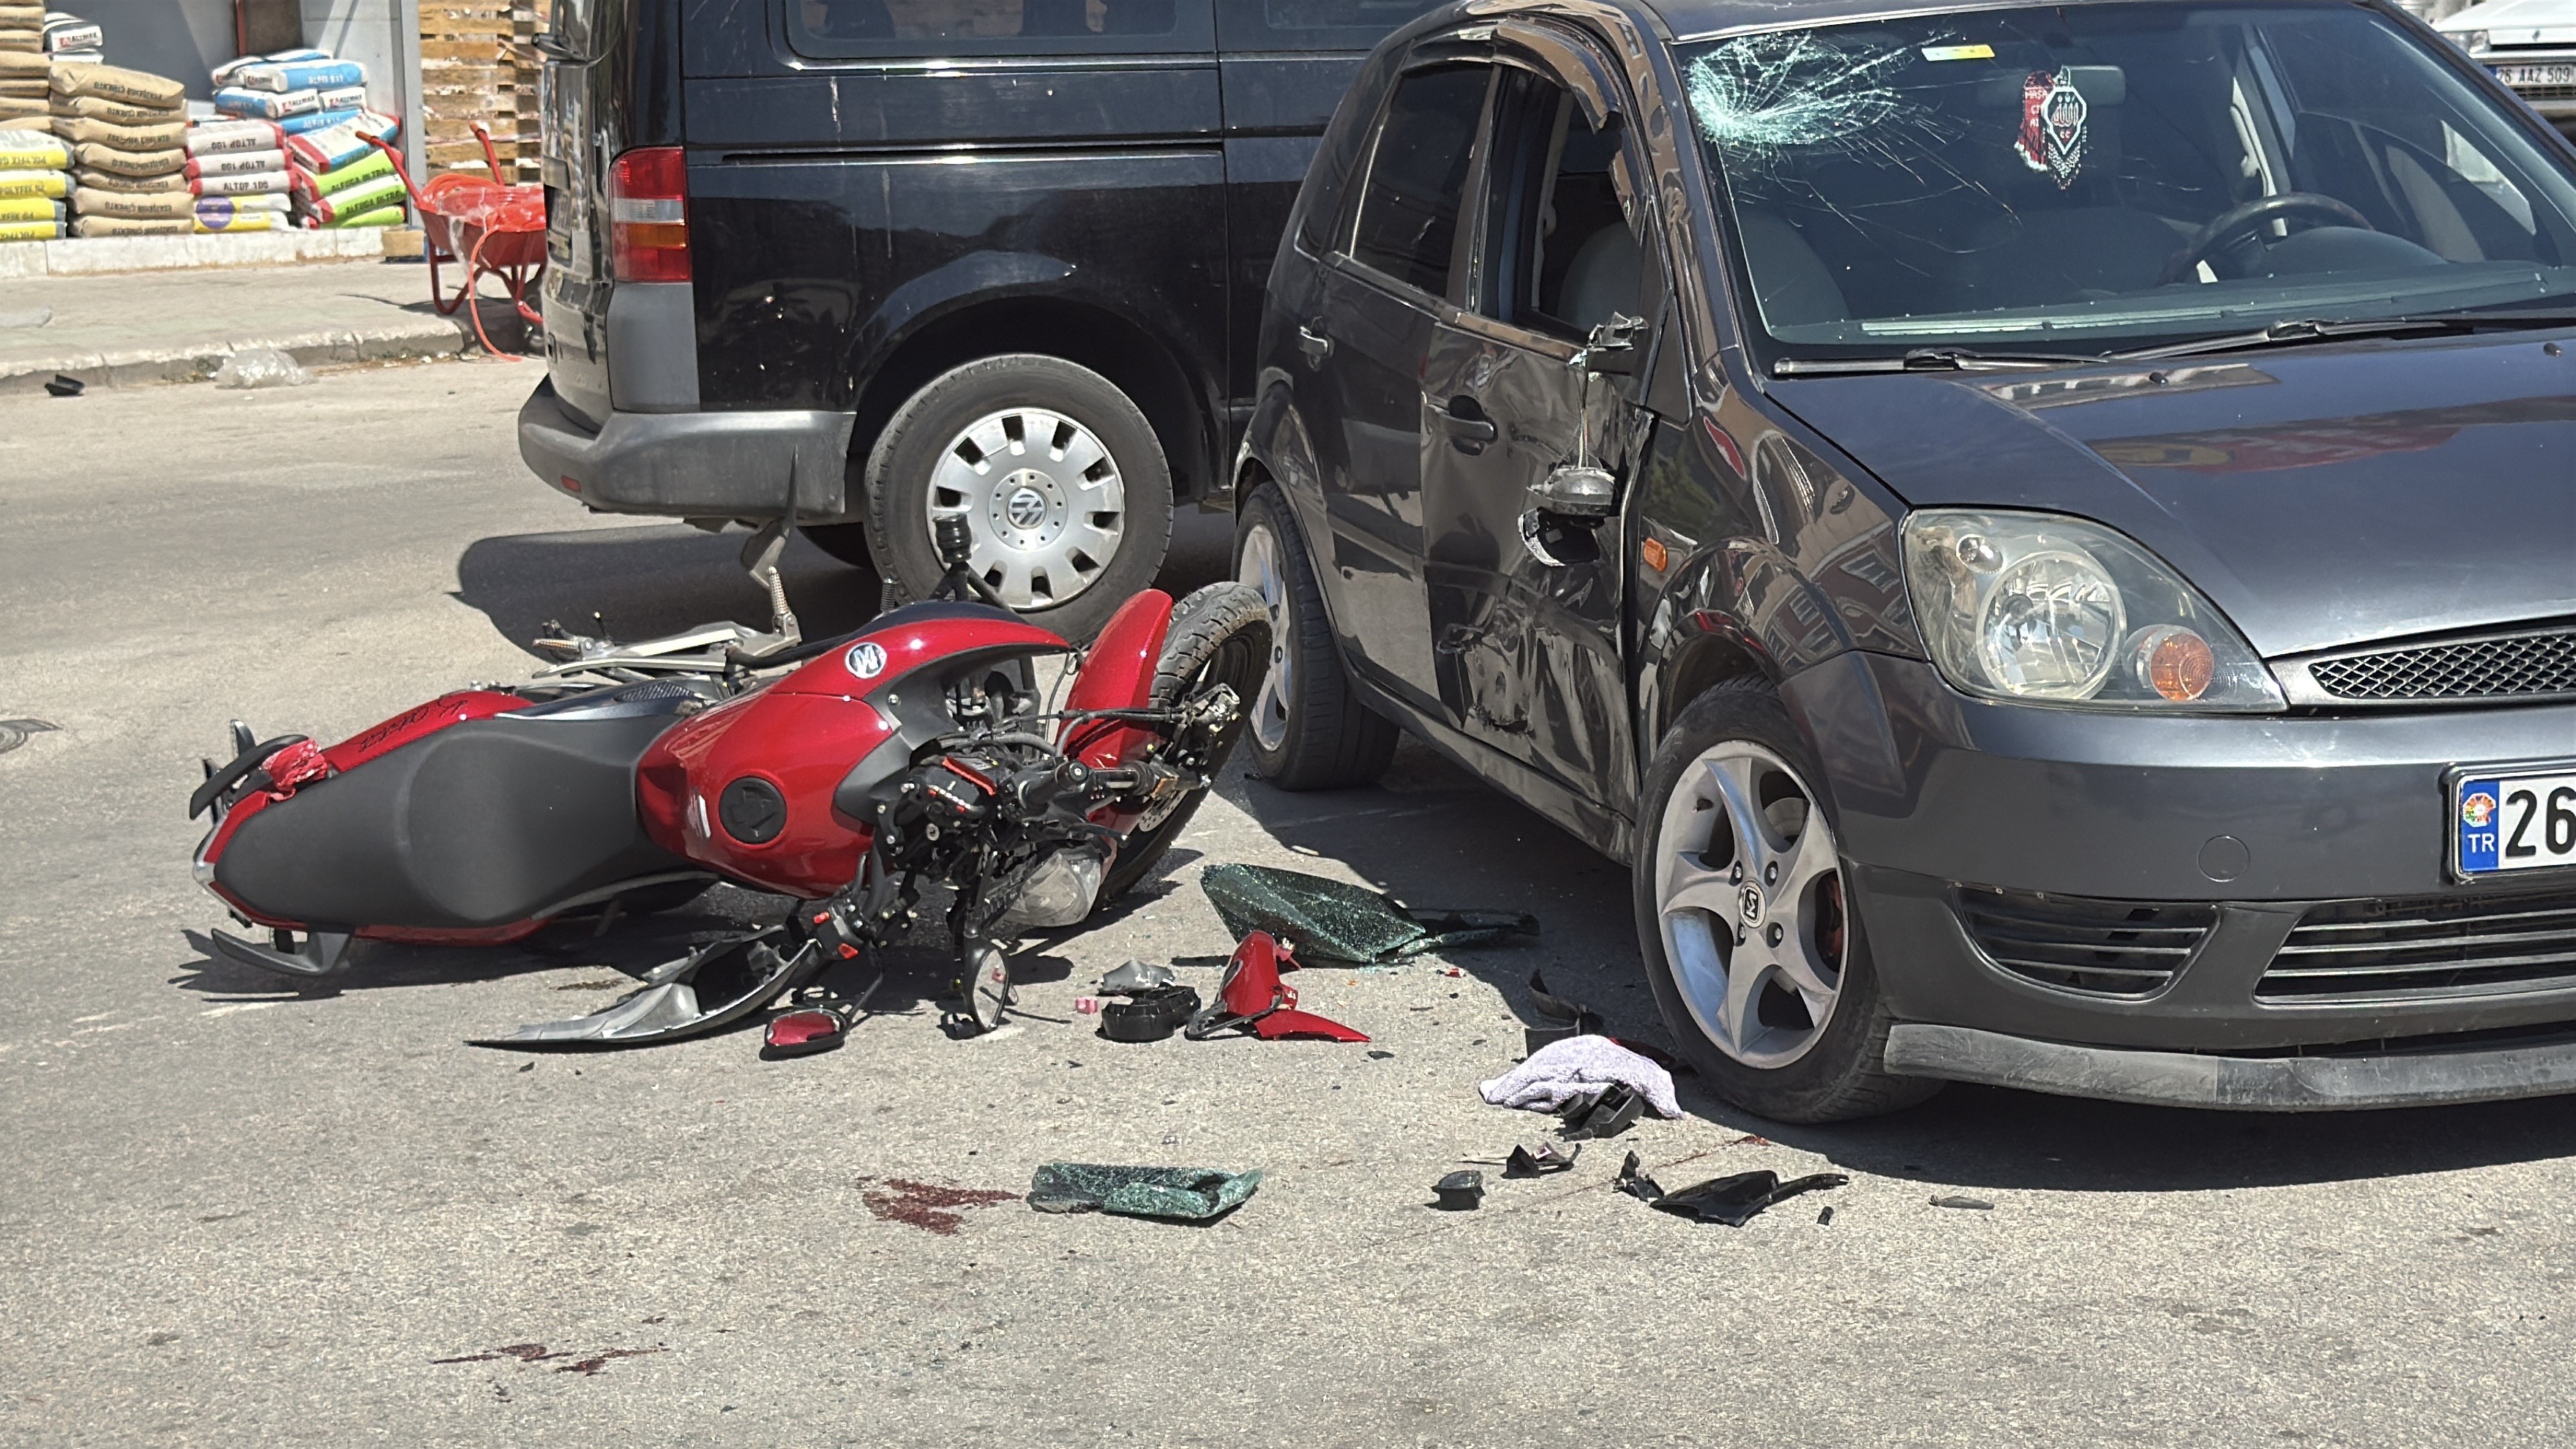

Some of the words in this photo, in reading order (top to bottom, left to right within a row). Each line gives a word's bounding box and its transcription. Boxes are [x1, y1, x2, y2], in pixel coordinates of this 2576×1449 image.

[2519, 68, 2542, 83] AAZ
[2547, 67, 2570, 82] 509
[2468, 833, 2495, 853] TR
[2505, 786, 2576, 858] 26
